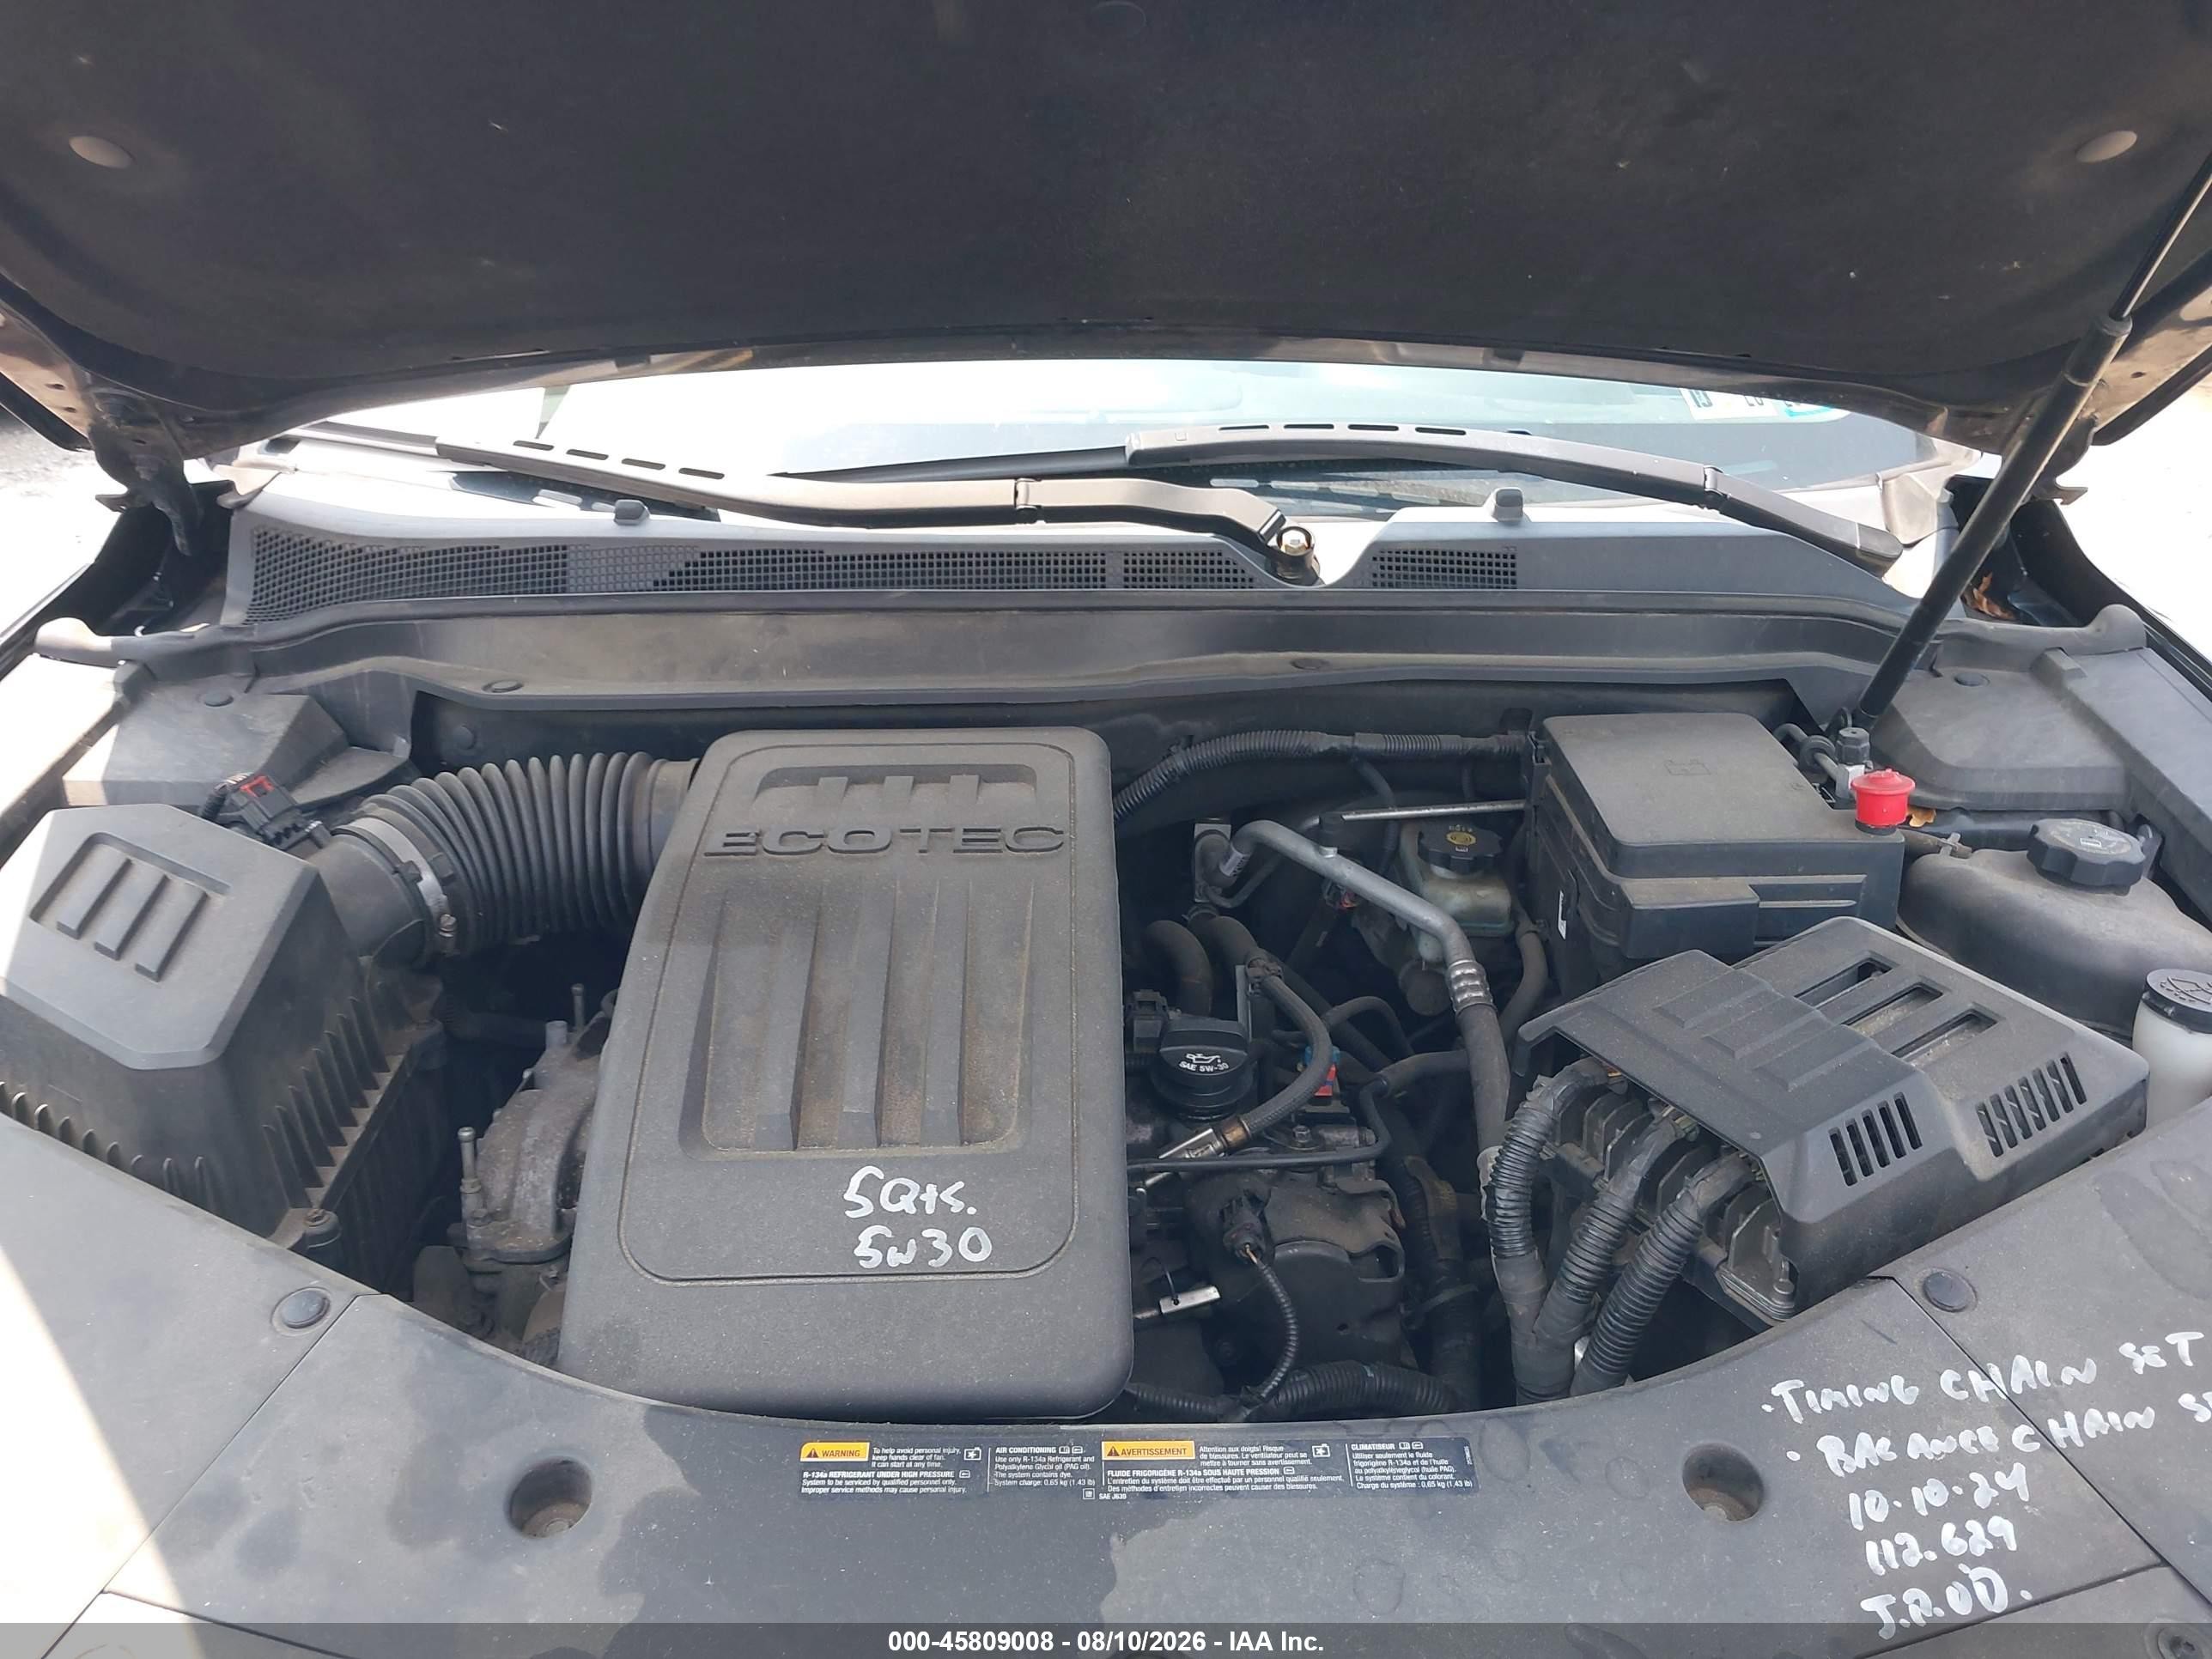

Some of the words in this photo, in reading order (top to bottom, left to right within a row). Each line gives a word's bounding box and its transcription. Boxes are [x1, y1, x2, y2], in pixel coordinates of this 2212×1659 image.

[704, 826, 1065, 856] ECOTEC
[1178, 1060, 1197, 1072] SAE
[1199, 1062, 1230, 1073] 5W-30
[1940, 1354, 2097, 1402] CHAIN
[2119, 1332, 2204, 1374] SET
[1866, 1516, 2017, 1576] 112.629
